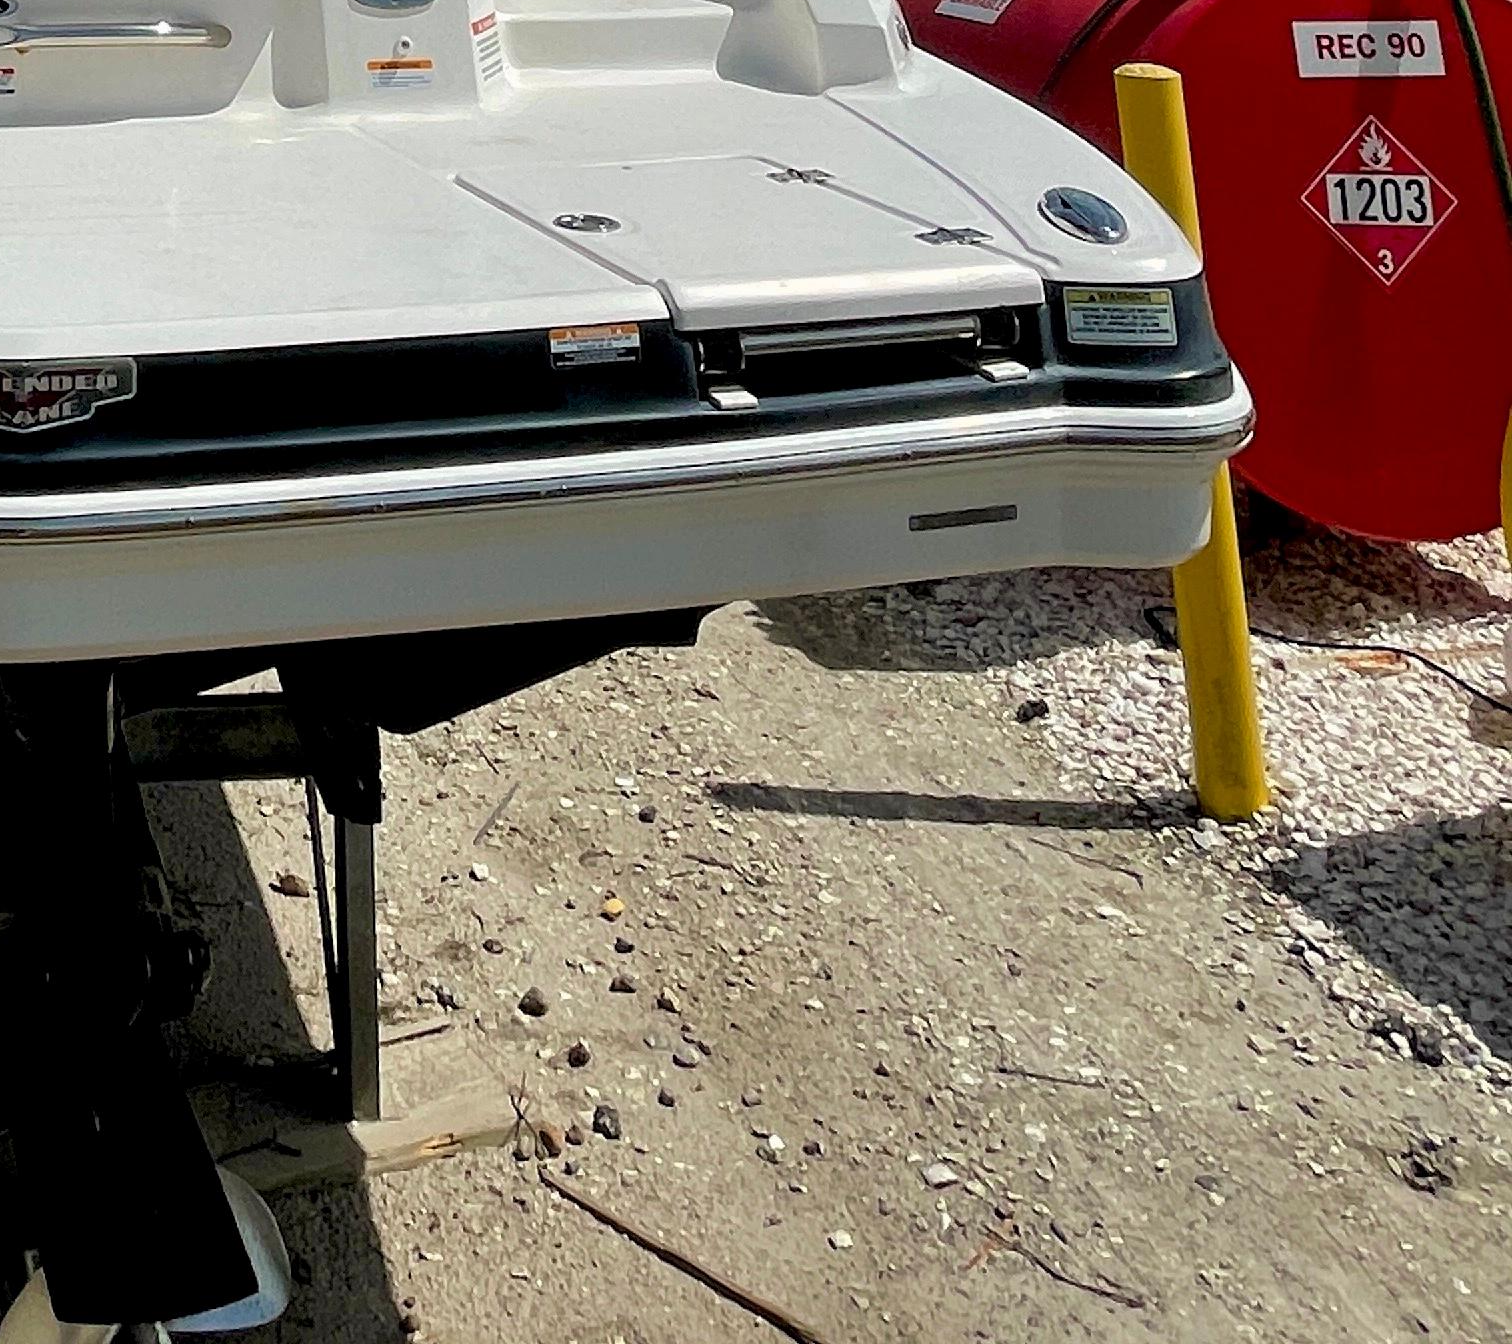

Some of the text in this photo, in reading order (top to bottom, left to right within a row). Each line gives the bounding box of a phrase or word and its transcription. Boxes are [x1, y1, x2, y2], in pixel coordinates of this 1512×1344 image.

[1315, 32, 1425, 59] REC 90
[1333, 177, 1427, 223] 1203
[1377, 249, 1394, 274] 3
